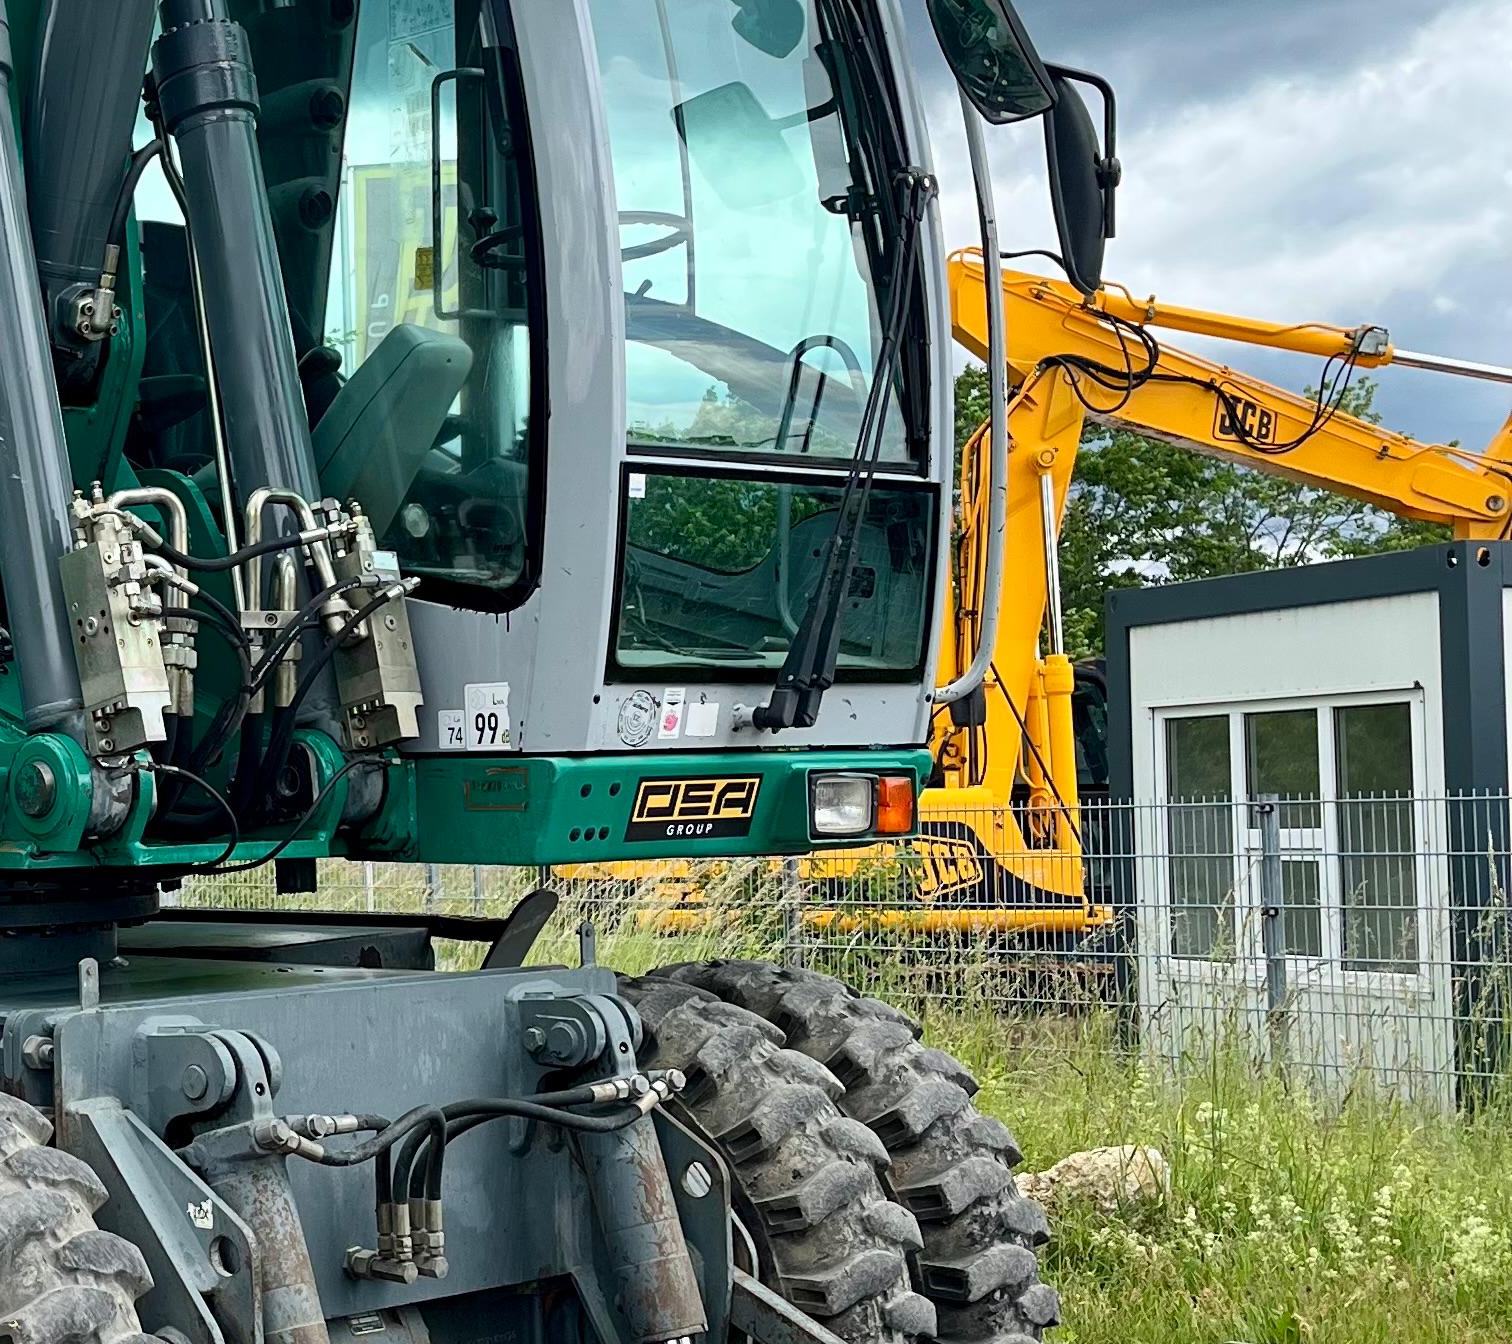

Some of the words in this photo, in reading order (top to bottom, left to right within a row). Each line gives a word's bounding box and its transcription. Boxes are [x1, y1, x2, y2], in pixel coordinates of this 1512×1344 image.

[1219, 395, 1272, 440] JCB
[447, 726, 463, 745] 74
[474, 712, 499, 745] 99
[666, 822, 714, 837] GROUP
